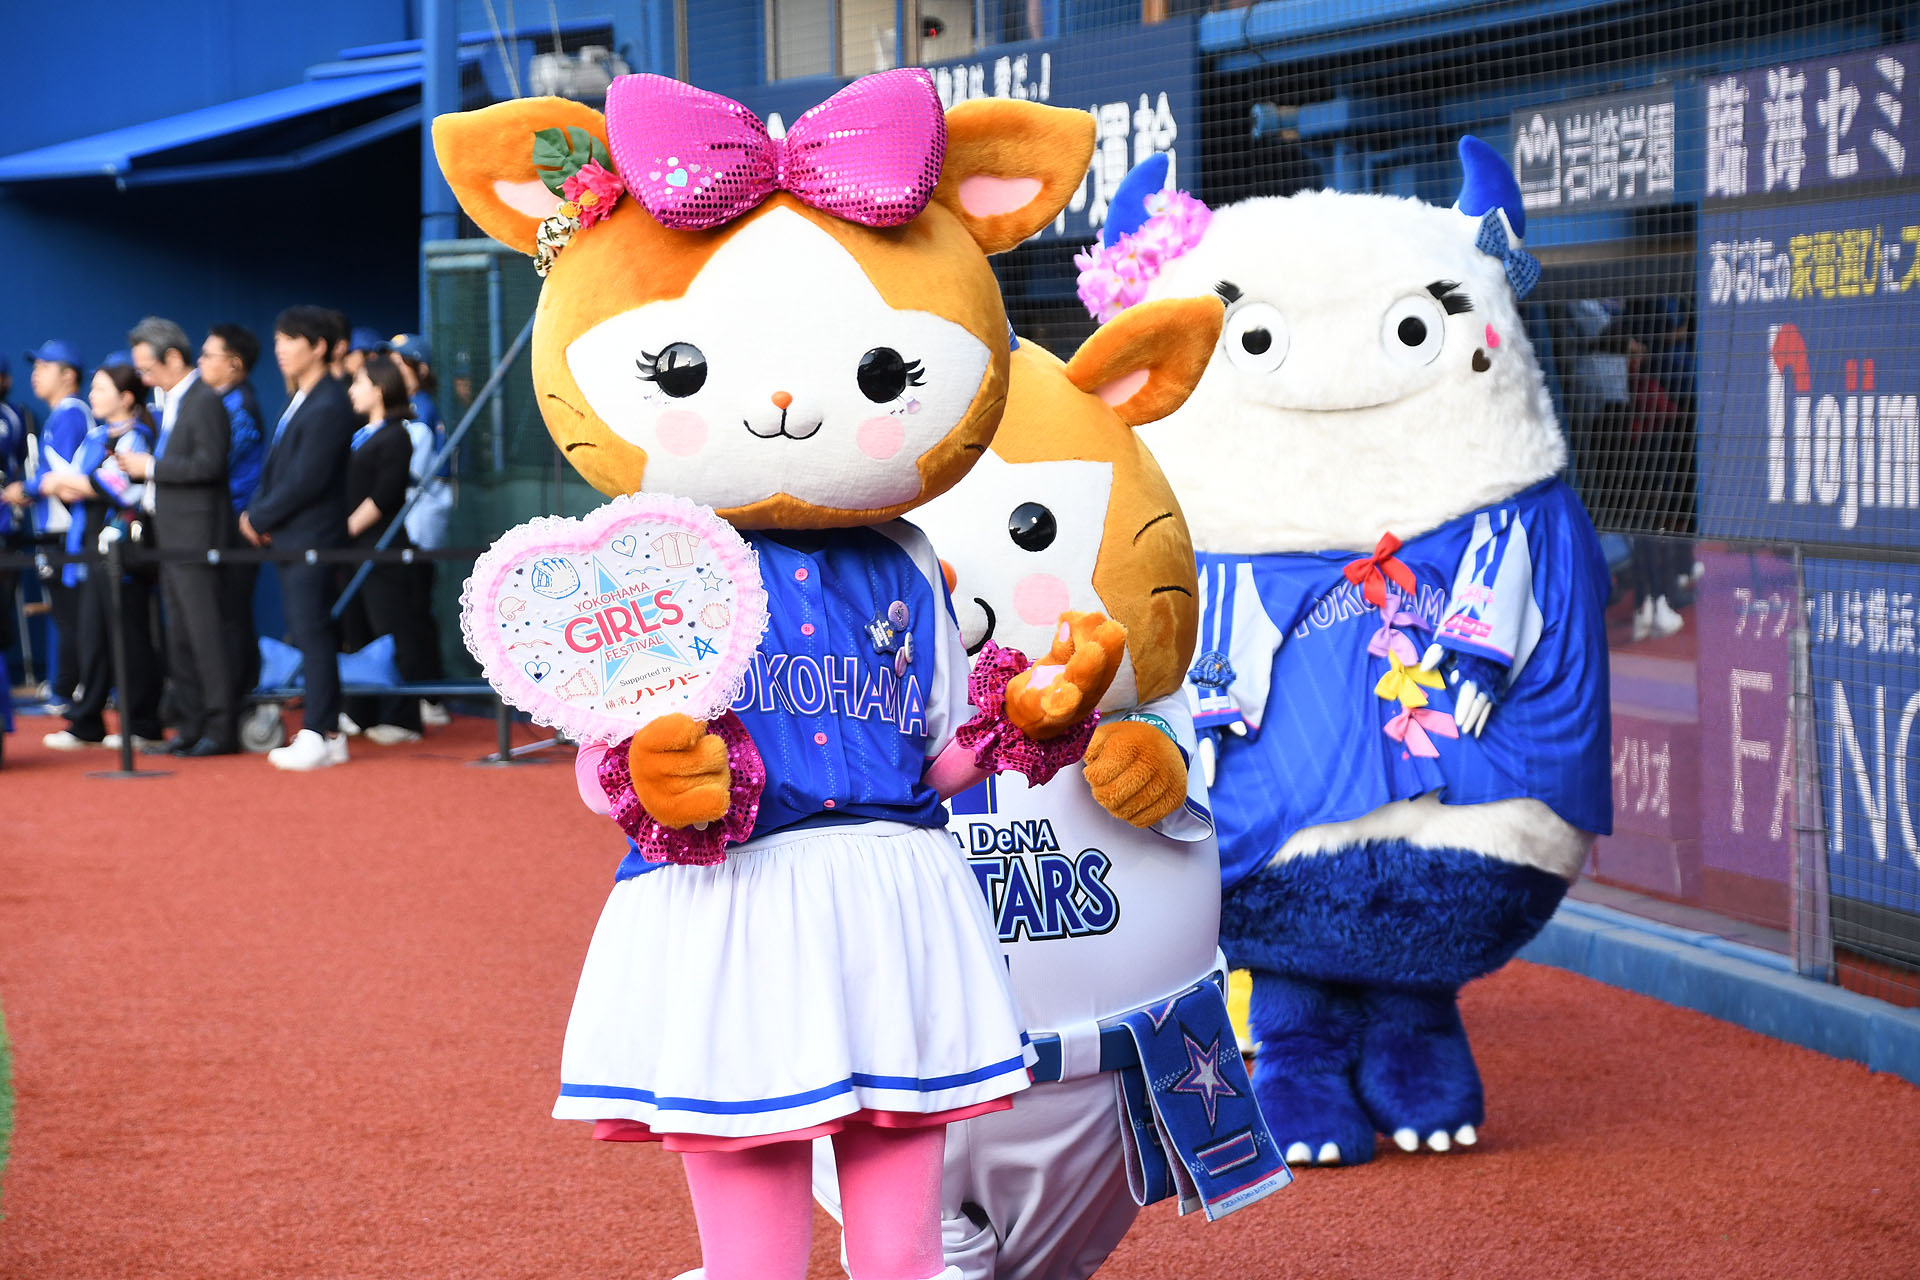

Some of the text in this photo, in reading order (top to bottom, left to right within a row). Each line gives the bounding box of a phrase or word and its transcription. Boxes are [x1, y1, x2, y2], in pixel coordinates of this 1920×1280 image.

[1562, 102, 1675, 203] 岩崎学園
[574, 582, 650, 613] YOKOHAMA
[564, 590, 684, 654] GIRLS
[605, 635, 665, 662] FESTIVAL
[620, 665, 672, 687] Supported by
[731, 652, 928, 737] KOHAMA
[969, 818, 1060, 855] DeNA
